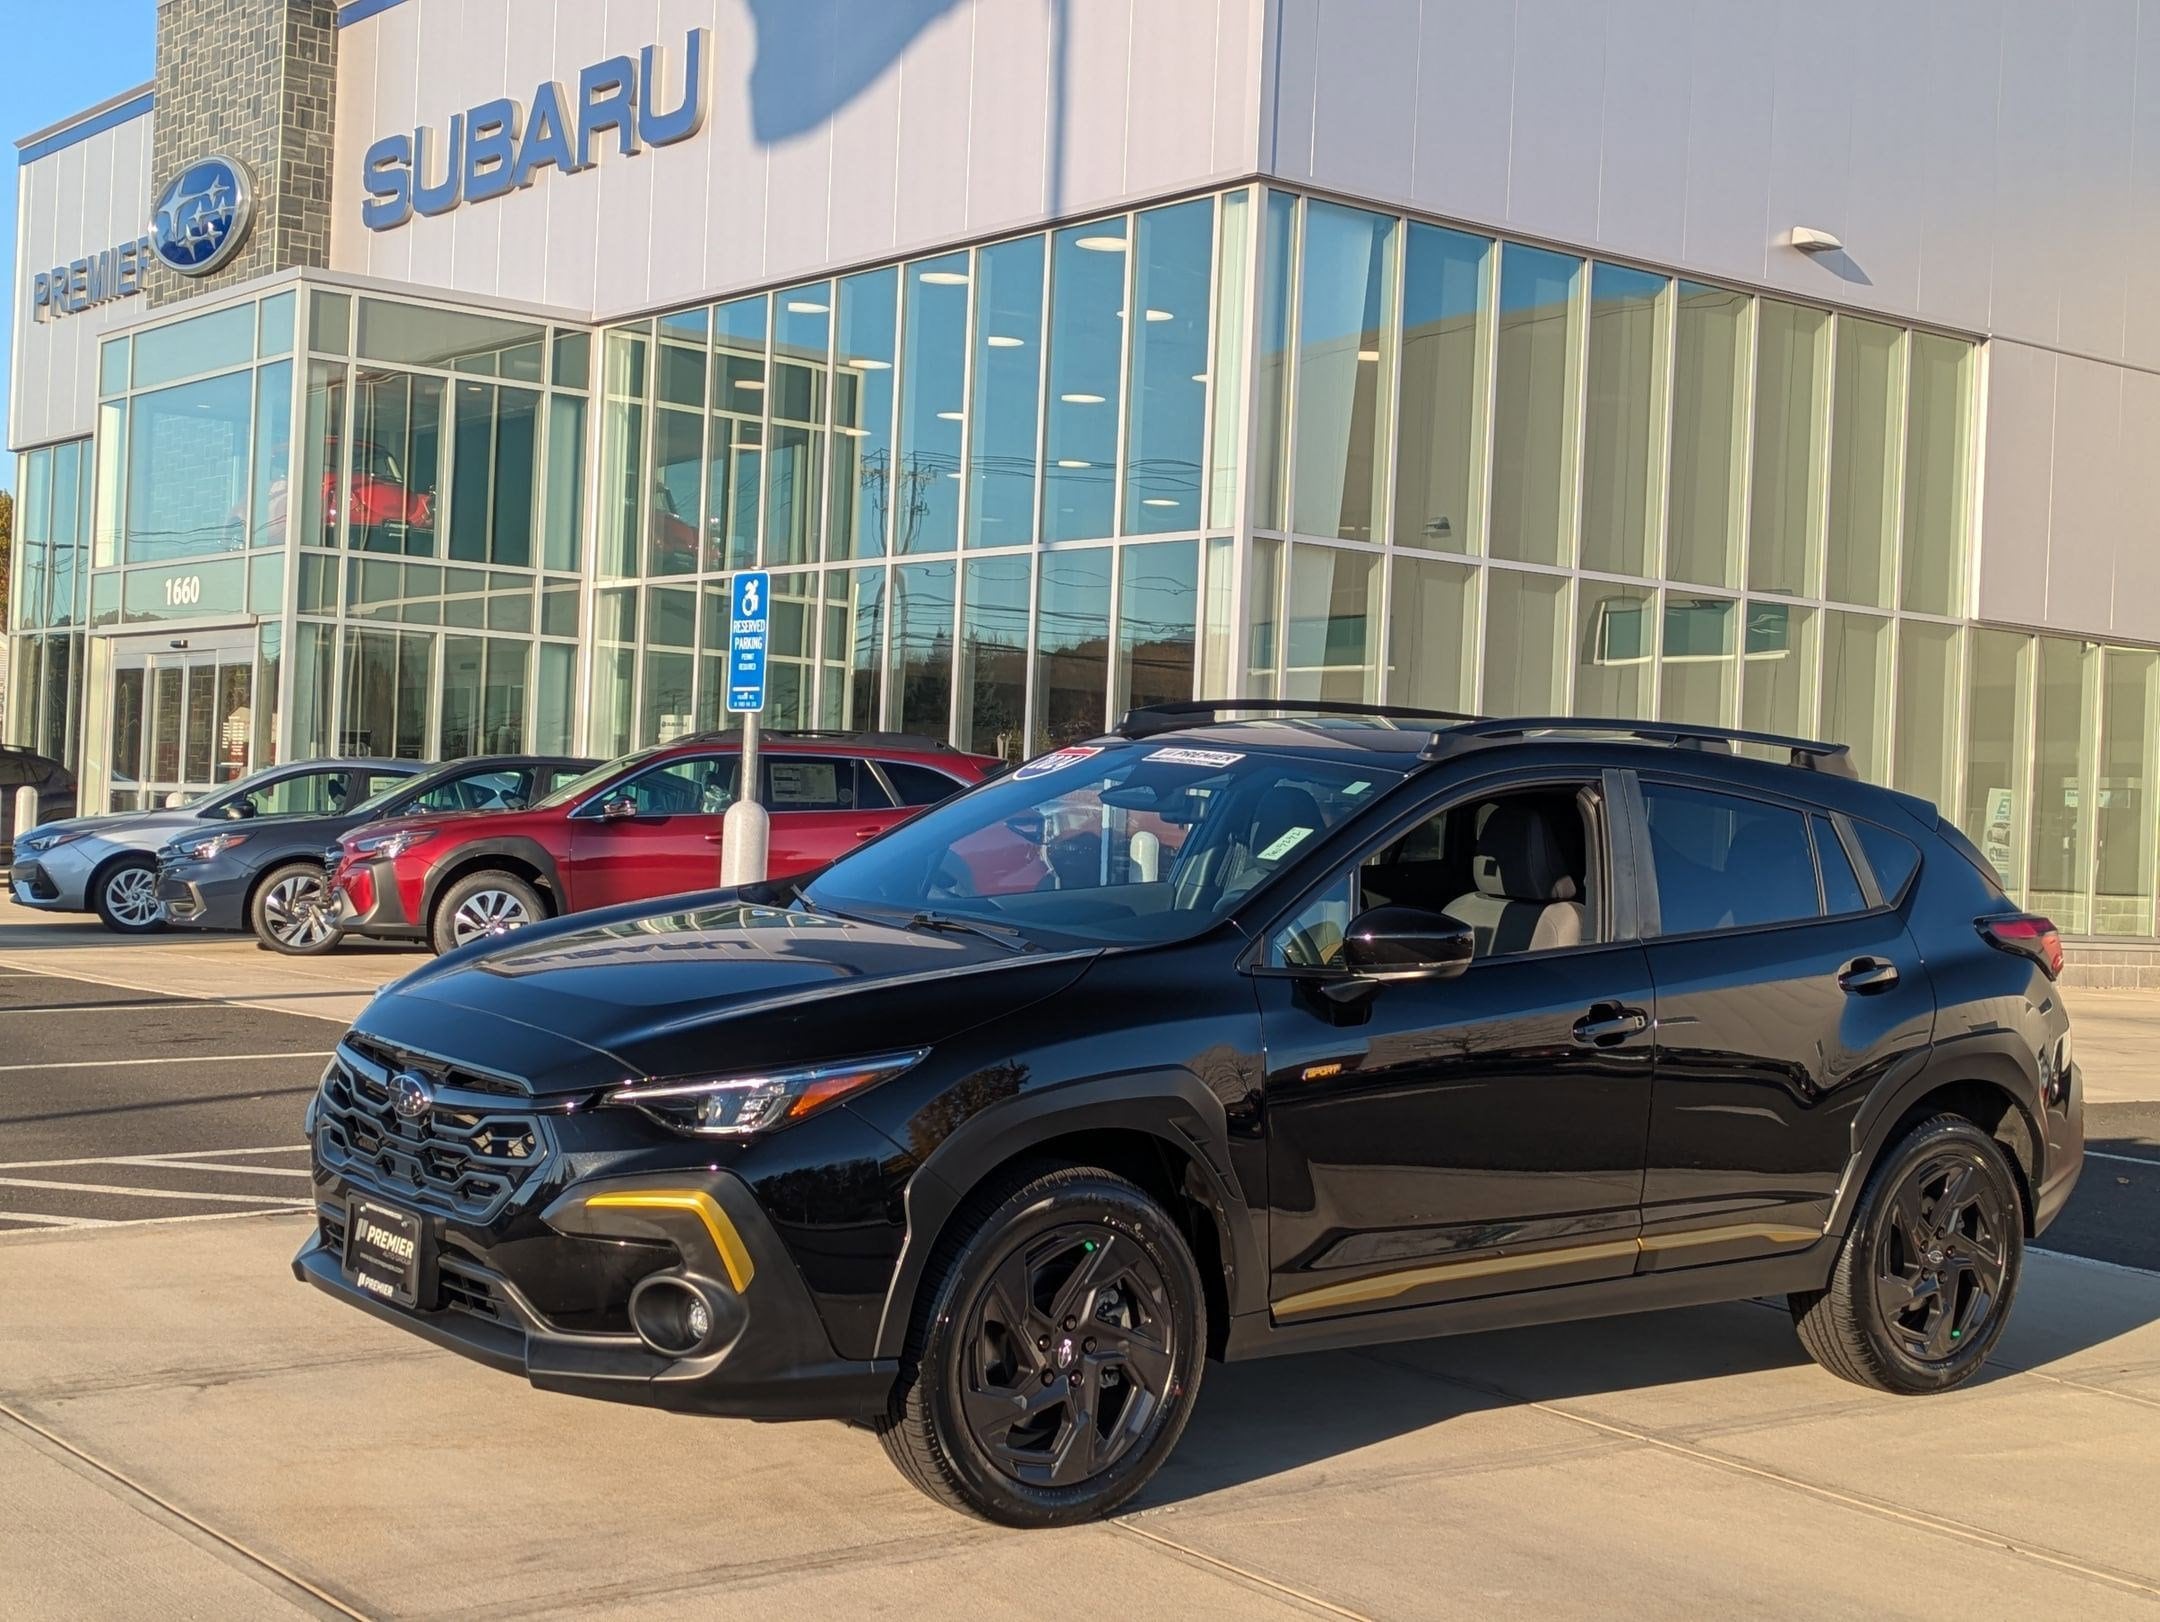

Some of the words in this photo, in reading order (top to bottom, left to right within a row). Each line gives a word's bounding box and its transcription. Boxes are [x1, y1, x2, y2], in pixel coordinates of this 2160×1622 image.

[361, 27, 710, 232] SUBARU
[165, 575, 200, 606] 1660
[733, 619, 766, 633] RESERVED
[734, 636, 763, 650] PARKING
[1173, 750, 1238, 762] PREMIER
[366, 1225, 414, 1260] PREMIER
[364, 1276, 394, 1298] PREMIER
